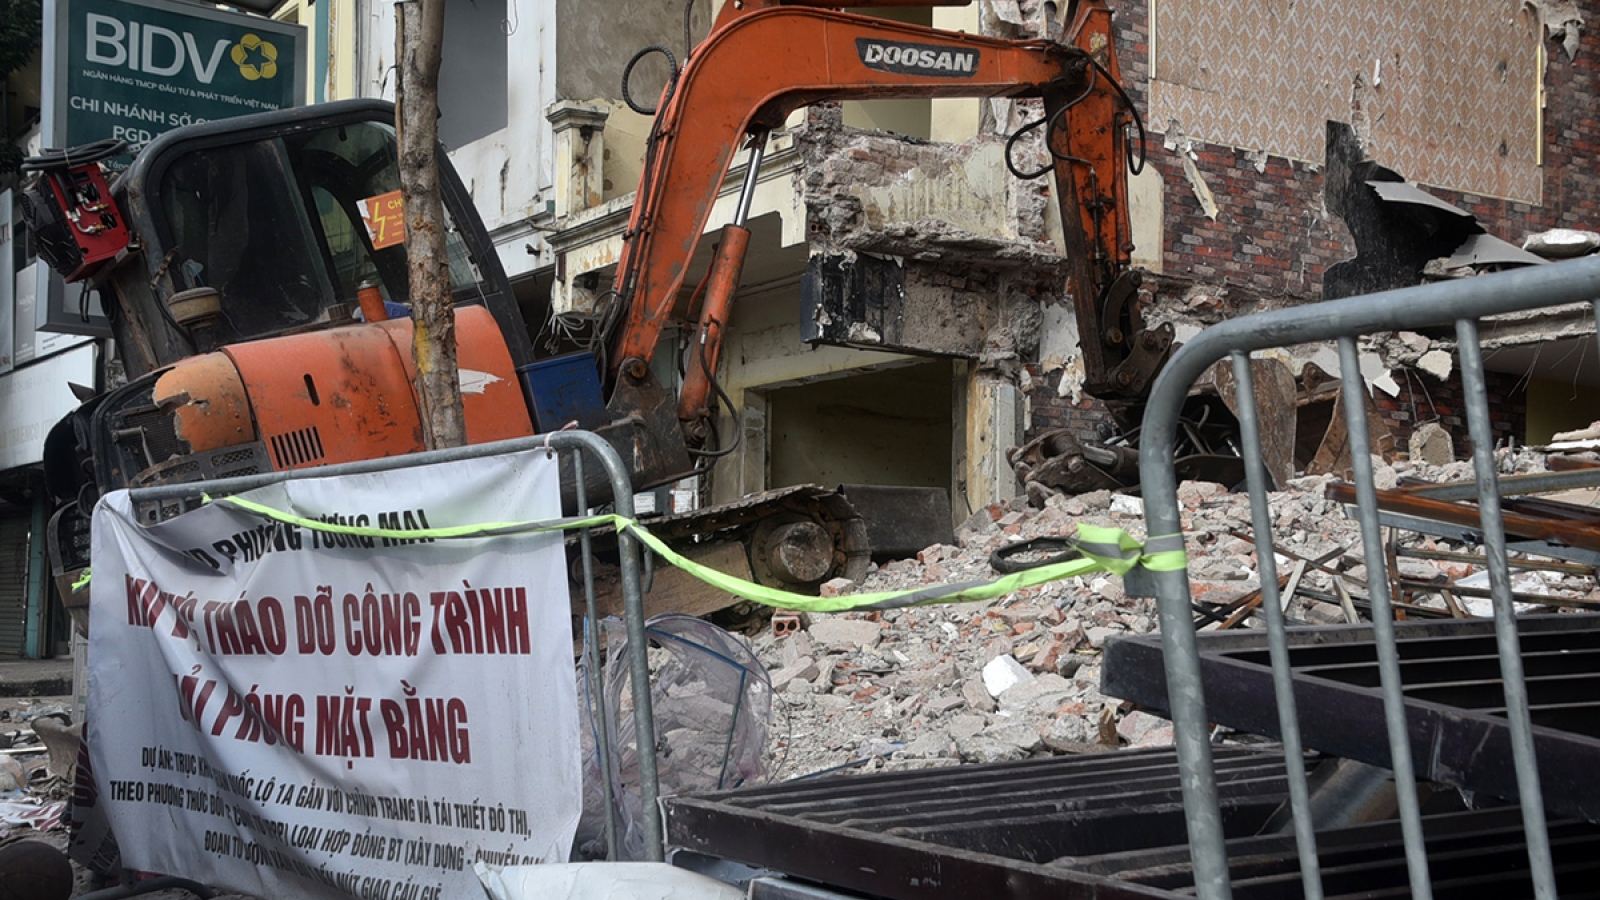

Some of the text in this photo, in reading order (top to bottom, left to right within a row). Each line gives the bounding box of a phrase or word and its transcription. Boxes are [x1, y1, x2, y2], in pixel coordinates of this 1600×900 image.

[86, 12, 232, 84] BIDV
[864, 43, 974, 73] DOOSAN
[70, 96, 100, 112] CHI
[103, 103, 165, 124] NHÁNH
[82, 69, 108, 81] NGÂN
[109, 75, 134, 86] HÀNG
[135, 79, 157, 90] TMCP
[260, 102, 279, 111] NAM
[112, 125, 152, 142] PGD
[378, 508, 436, 548] MAI
[203, 590, 287, 656] THÁO
[294, 584, 336, 656] DỠ
[343, 582, 421, 657] CÔNG
[430, 579, 531, 656] TRÌNH
[315, 685, 375, 770] MẶT
[380, 679, 471, 765] BẰNG
[142, 746, 157, 773] DỰ
[158, 745, 174, 771] ÁN:
[174, 751, 197, 779] TRỤC
[255, 776, 276, 808] LỘ
[276, 783, 296, 807] 1A
[295, 779, 325, 811] GẮN
[326, 785, 344, 814] VỚI
[378, 795, 416, 822] TRANG
[416, 795, 432, 825] VÀ
[433, 796, 453, 827] TÁI
[453, 797, 486, 831] THIẾT
[488, 802, 506, 833] ĐÔ
[508, 808, 532, 842] THỊ,
[109, 781, 145, 802] THEO
[147, 782, 184, 808] PHƯƠNG
[186, 786, 209, 813] THỨC
[291, 824, 322, 855] LOẠI
[320, 828, 352, 859] HỢP
[387, 836, 403, 863] BT
[404, 836, 432, 867] (XÂY
[433, 842, 464, 875] DỰNG
[205, 830, 231, 859] ĐOẠN
